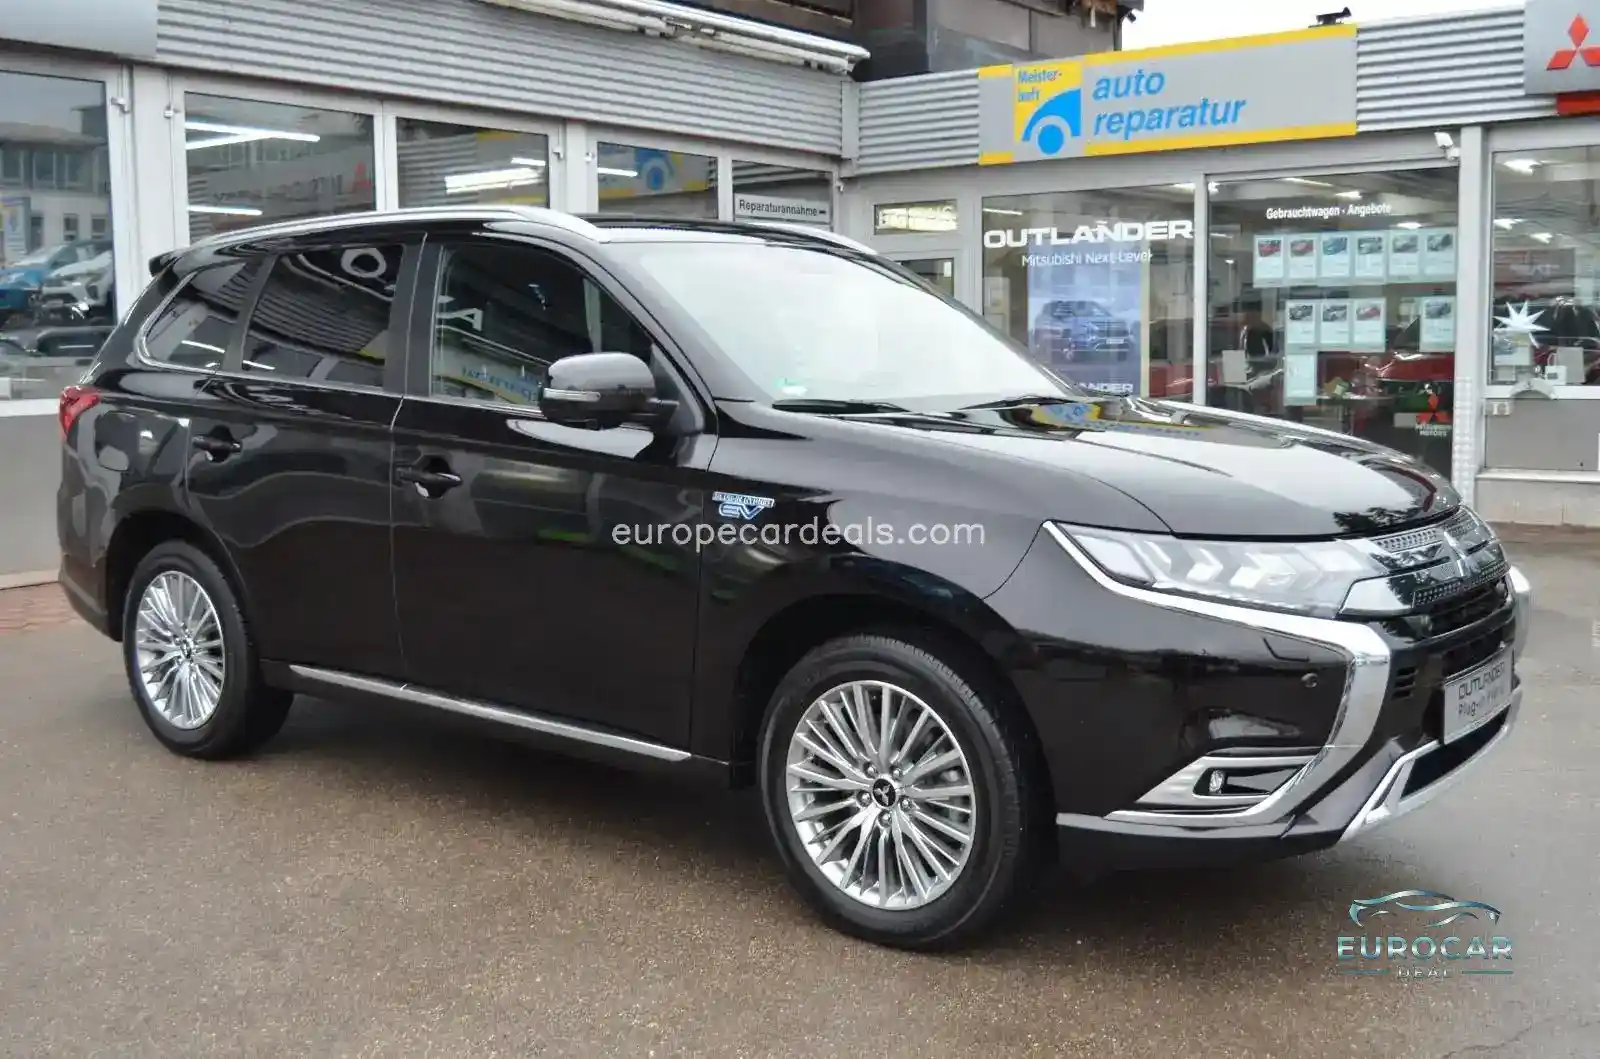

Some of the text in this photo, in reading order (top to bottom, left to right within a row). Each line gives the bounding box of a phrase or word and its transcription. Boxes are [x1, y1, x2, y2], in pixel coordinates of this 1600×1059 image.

[1093, 69, 1165, 101] auto
[1094, 98, 1246, 140] reparatur
[739, 199, 818, 216] Reparaturannahme
[1266, 206, 1340, 220] Gebrauchtwagen
[1347, 203, 1392, 217] Angebote
[983, 219, 1194, 249] OUTLANDER
[1021, 252, 1082, 267] Mitsubishi
[1085, 250, 1114, 265] Next
